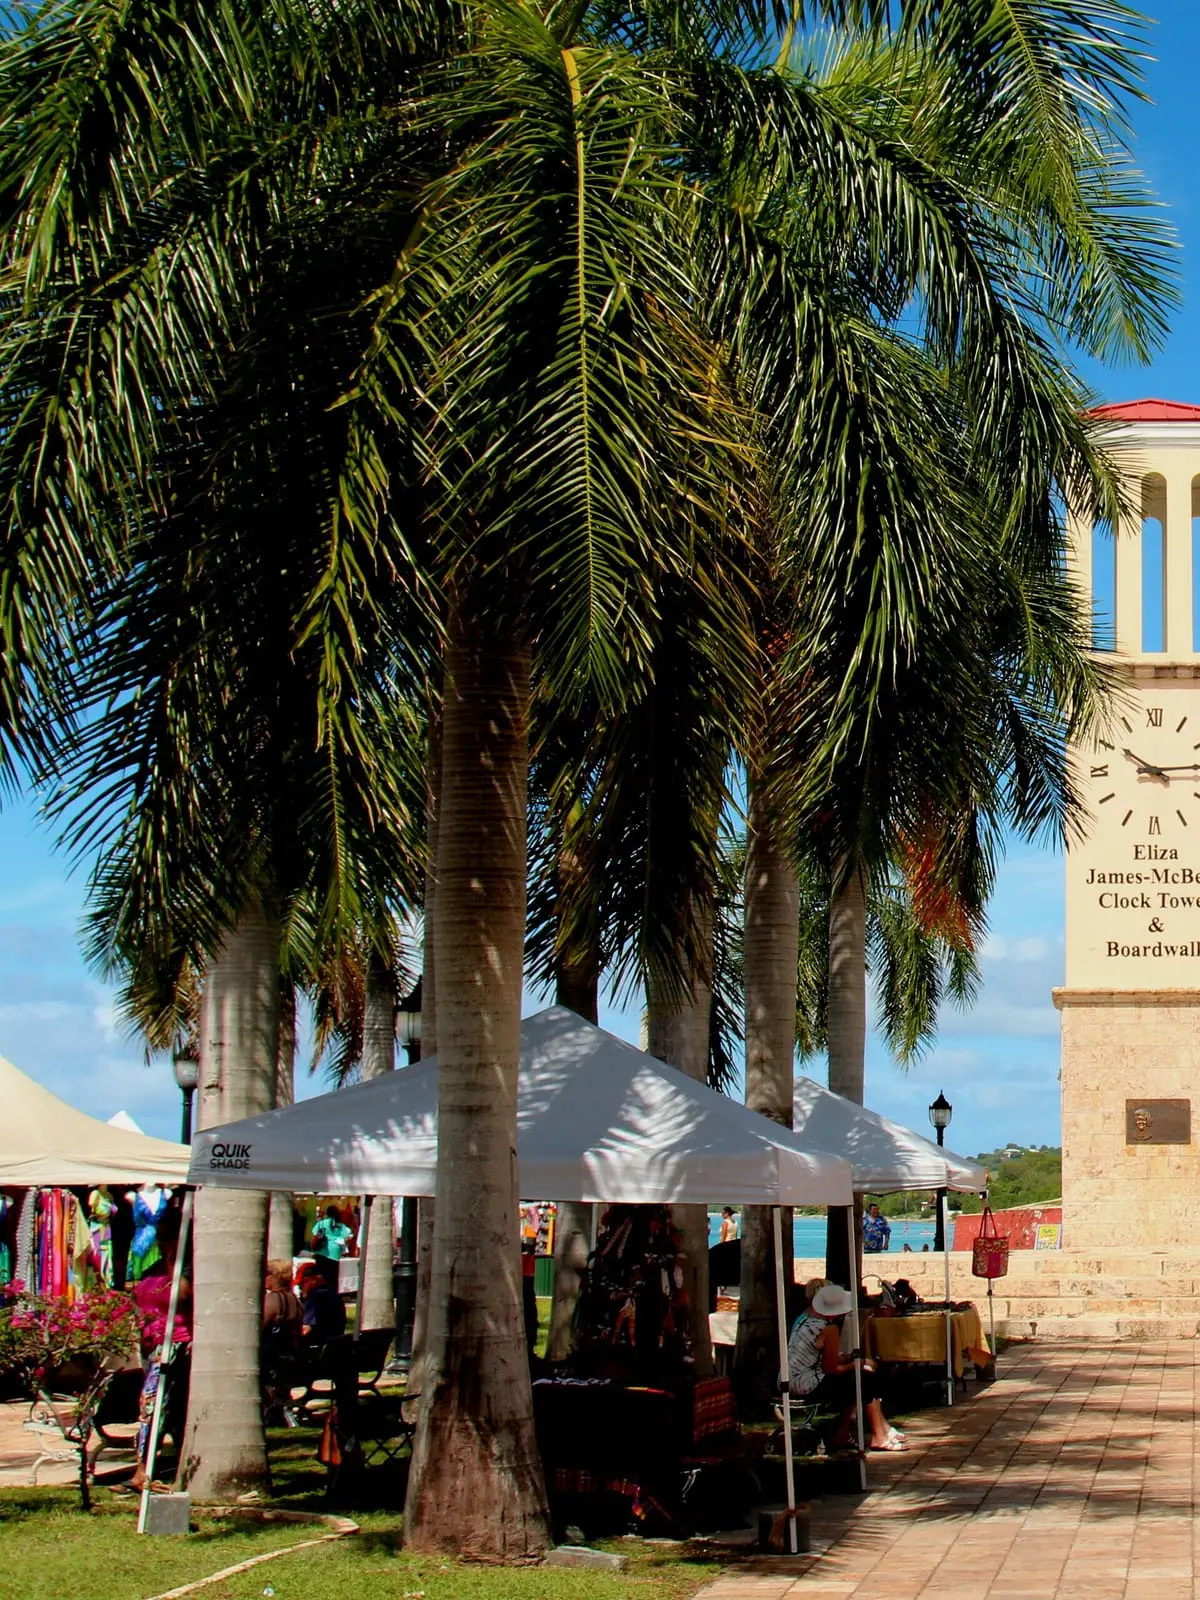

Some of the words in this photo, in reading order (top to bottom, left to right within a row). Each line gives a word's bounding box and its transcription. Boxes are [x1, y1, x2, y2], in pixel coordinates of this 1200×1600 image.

[1146, 708, 1163, 727] XII
[1133, 844, 1178, 861] Eliza
[1098, 892, 1152, 909] Clock
[1148, 916, 1165, 933] &
[212, 1143, 252, 1158] QUIK
[210, 1158, 250, 1169] SHADE
